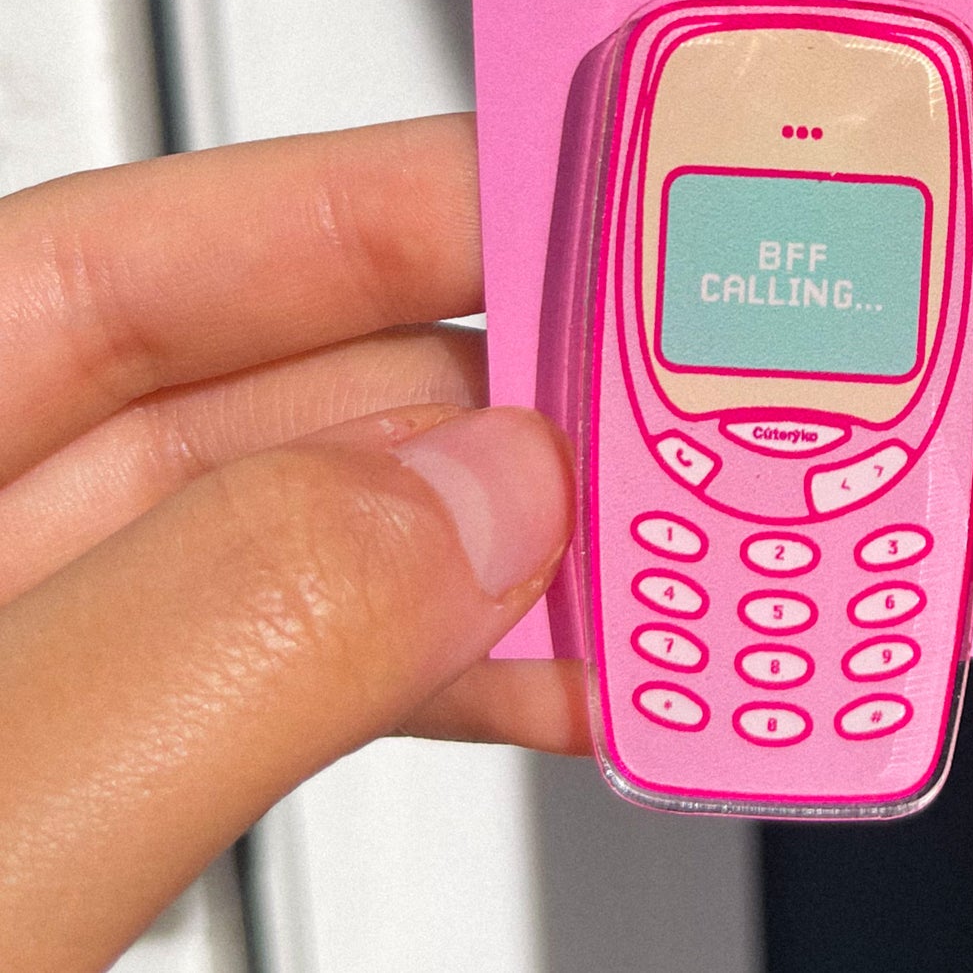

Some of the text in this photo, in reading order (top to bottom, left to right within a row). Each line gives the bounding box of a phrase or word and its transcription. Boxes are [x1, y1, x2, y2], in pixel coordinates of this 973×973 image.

[759, 240, 827, 272] BFF
[700, 274, 884, 311] CALLING...
[774, 544, 785, 561] 2
[888, 540, 898, 555] 3
[664, 586, 895, 620] 4 5 6
[664, 637, 892, 675] 7 8 9
